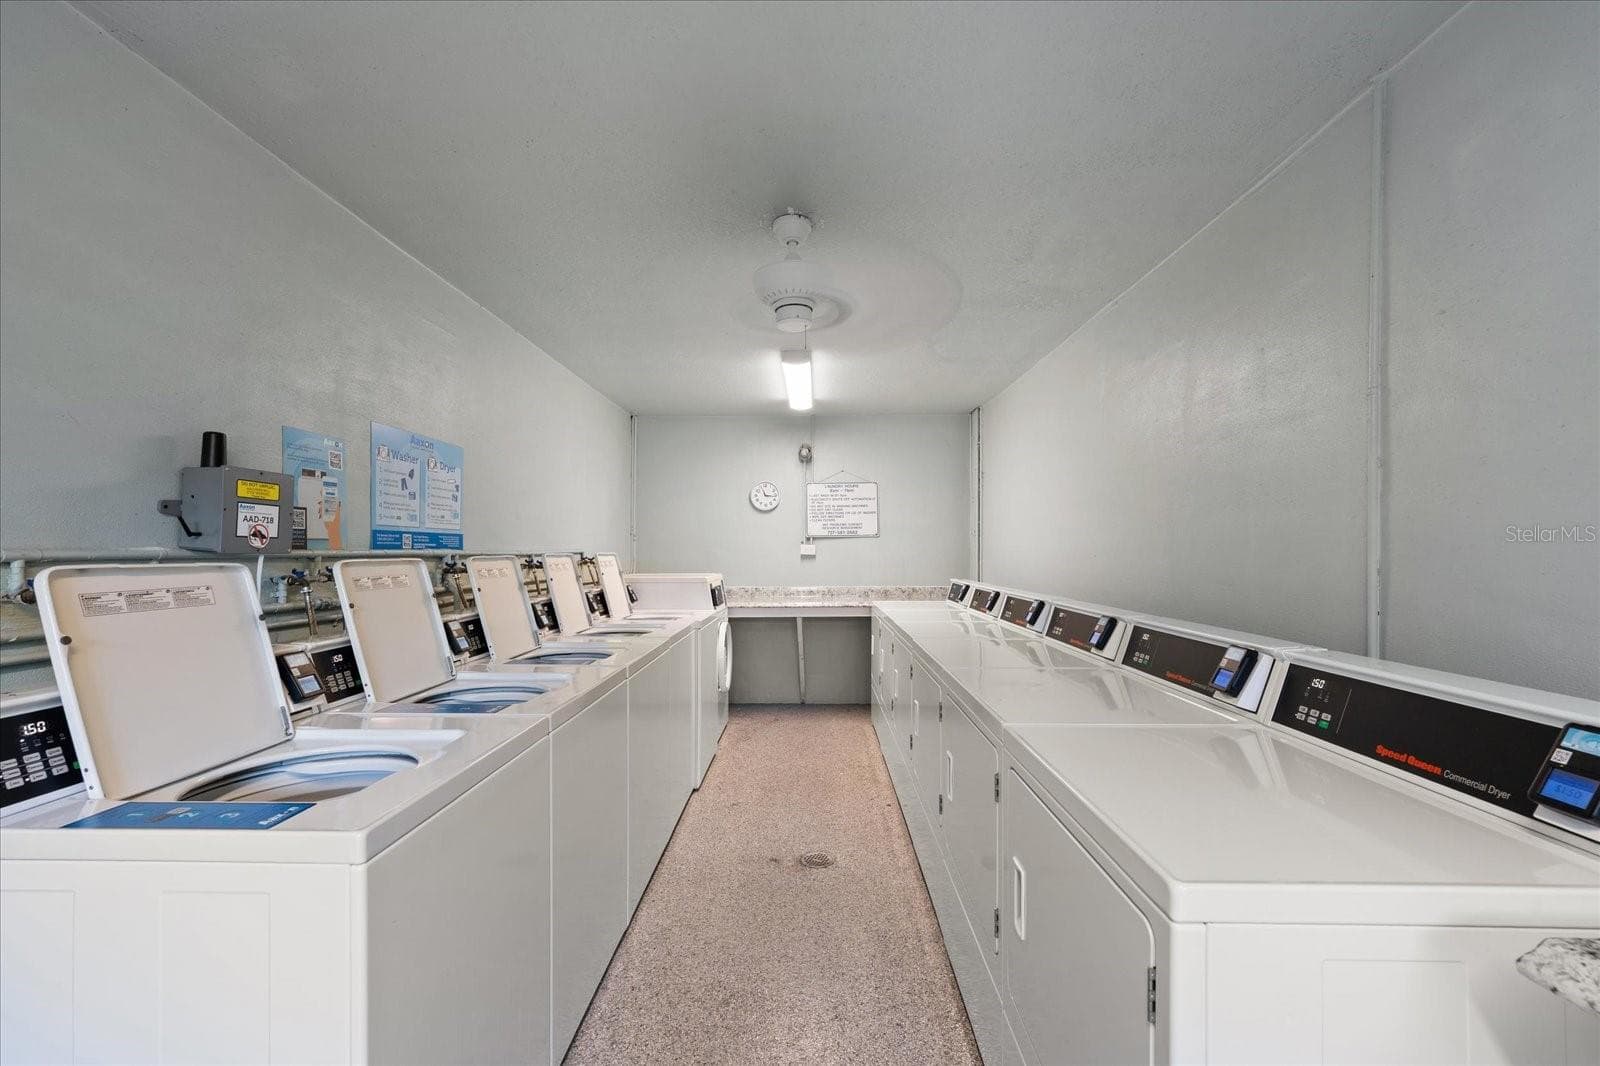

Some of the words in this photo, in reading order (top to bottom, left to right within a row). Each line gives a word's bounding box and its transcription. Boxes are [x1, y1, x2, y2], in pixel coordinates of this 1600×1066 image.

[391, 449, 419, 464] Washer
[440, 461, 456, 473] Dryer
[243, 515, 274, 524] AAD-718
[1376, 745, 1408, 762] Speed
[1408, 755, 1441, 775] Queen
[1443, 770, 1488, 792] Commercial
[1488, 785, 1511, 800] Dryer
